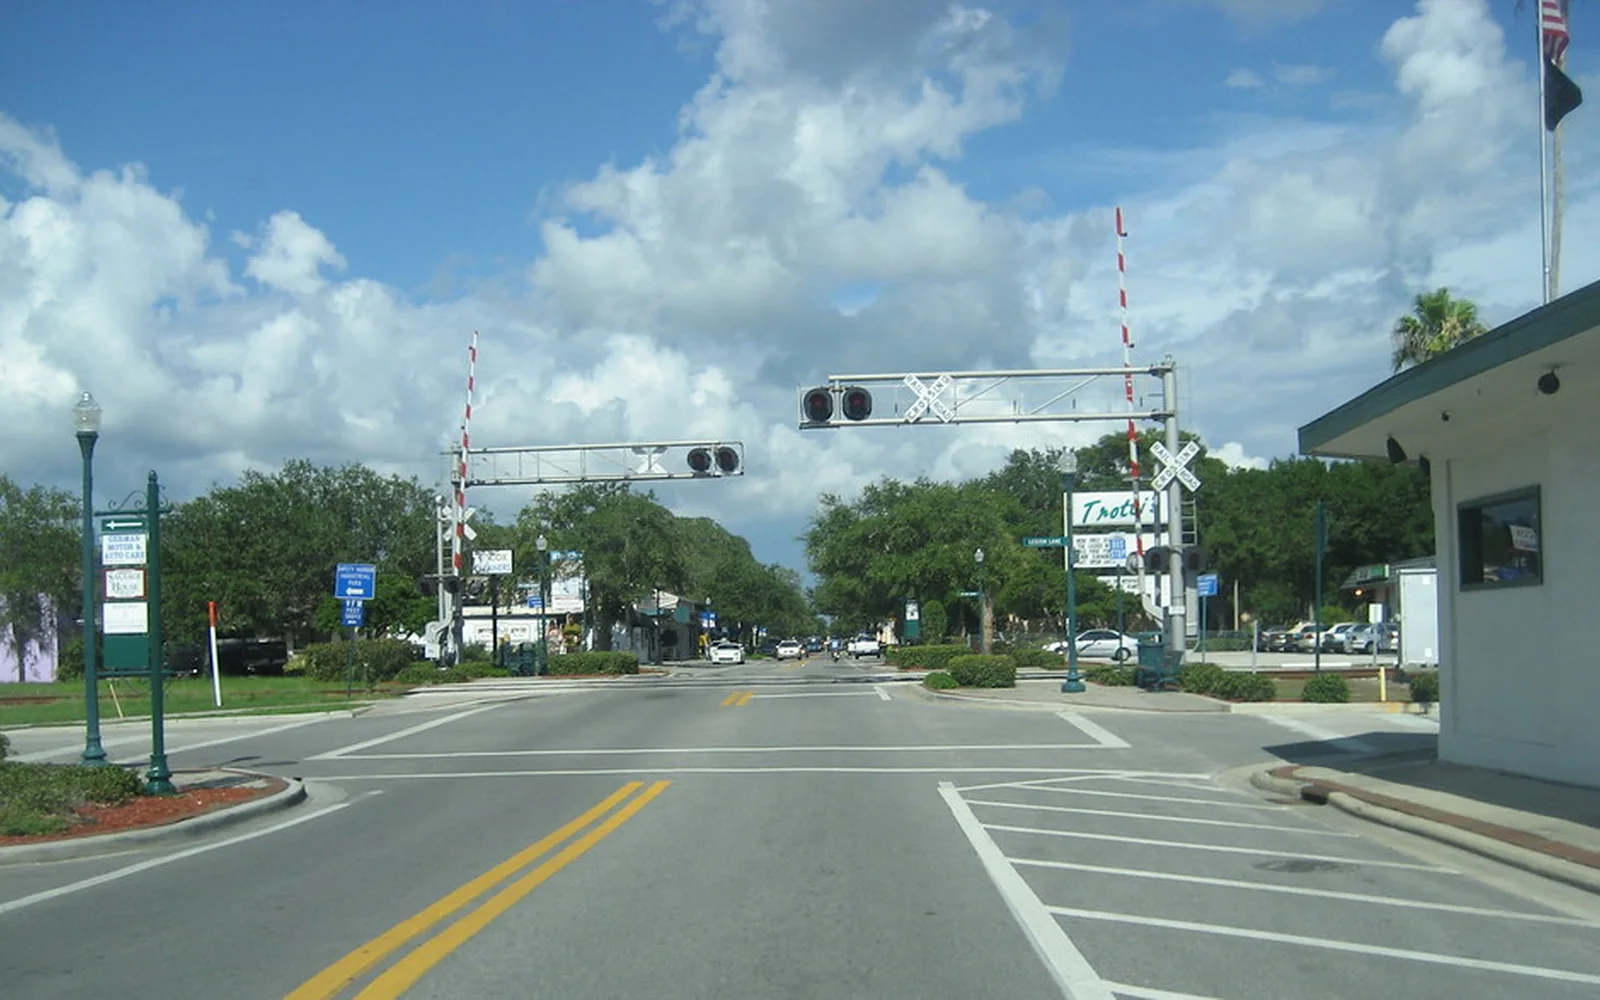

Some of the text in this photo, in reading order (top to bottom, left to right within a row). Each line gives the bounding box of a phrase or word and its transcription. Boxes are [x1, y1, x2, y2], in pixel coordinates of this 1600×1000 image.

[906, 375, 923, 393] RAIL
[908, 375, 949, 420] CROSSING
[933, 401, 951, 420] ROAD
[1153, 444, 1169, 462] RAIL
[1154, 444, 1196, 488] CROSSING
[1180, 470, 1198, 488] ROAD
[105, 551, 144, 559] AUTO CARE
